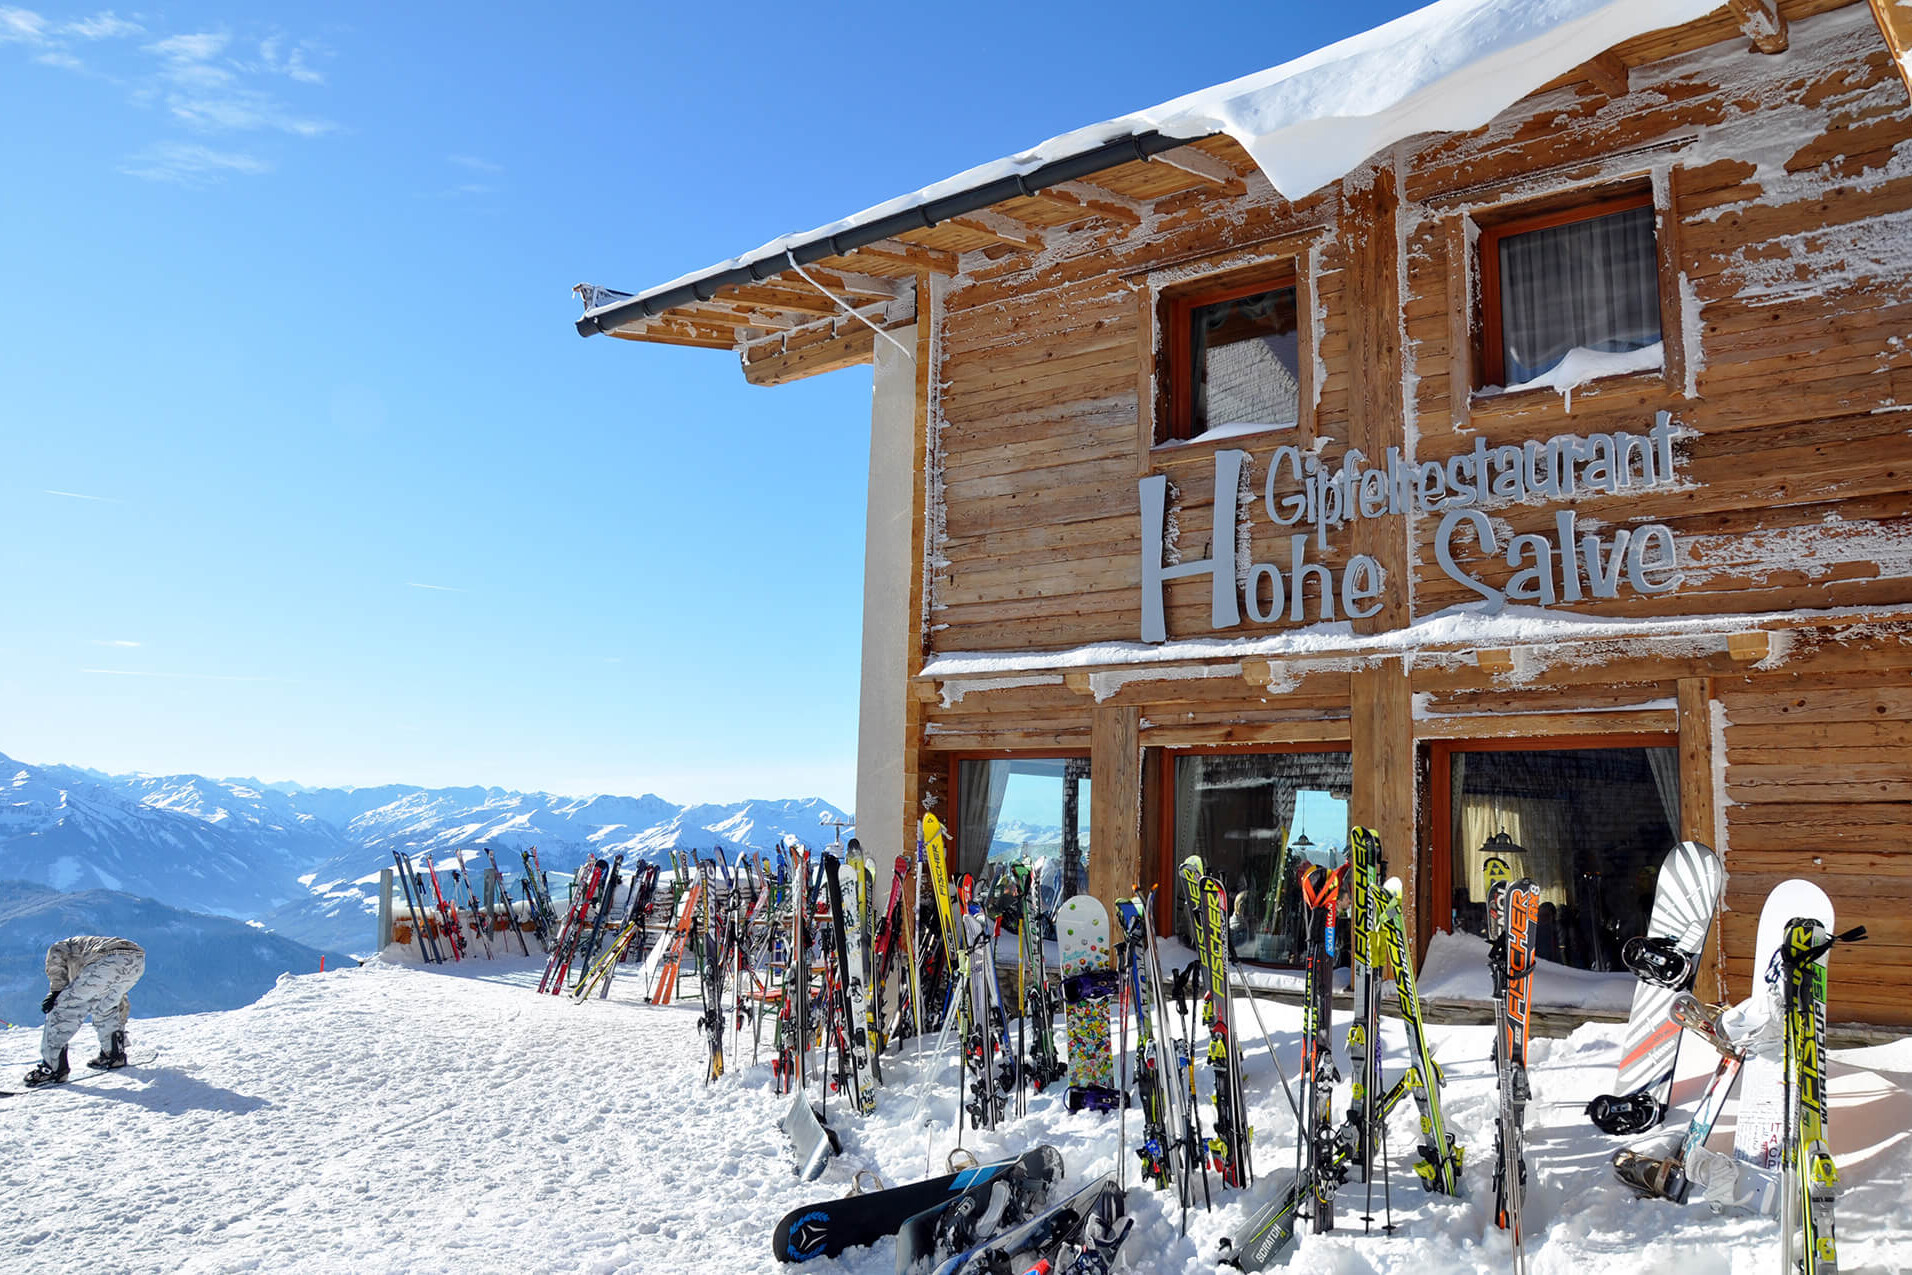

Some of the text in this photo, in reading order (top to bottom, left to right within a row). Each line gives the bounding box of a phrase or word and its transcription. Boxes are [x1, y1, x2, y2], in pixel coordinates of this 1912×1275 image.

[1265, 409, 1681, 550] Gipfelrestaurant
[1139, 449, 1685, 643] Hohe Salve
[707, 864, 716, 941] ATOMIC
[931, 843, 947, 897] FISCHER
[1325, 902, 1335, 953] SALOMON
[1352, 829, 1368, 965] FISCHER
[1206, 892, 1225, 999] FISCHER
[1814, 1002, 1828, 1125] WORLDCUP
